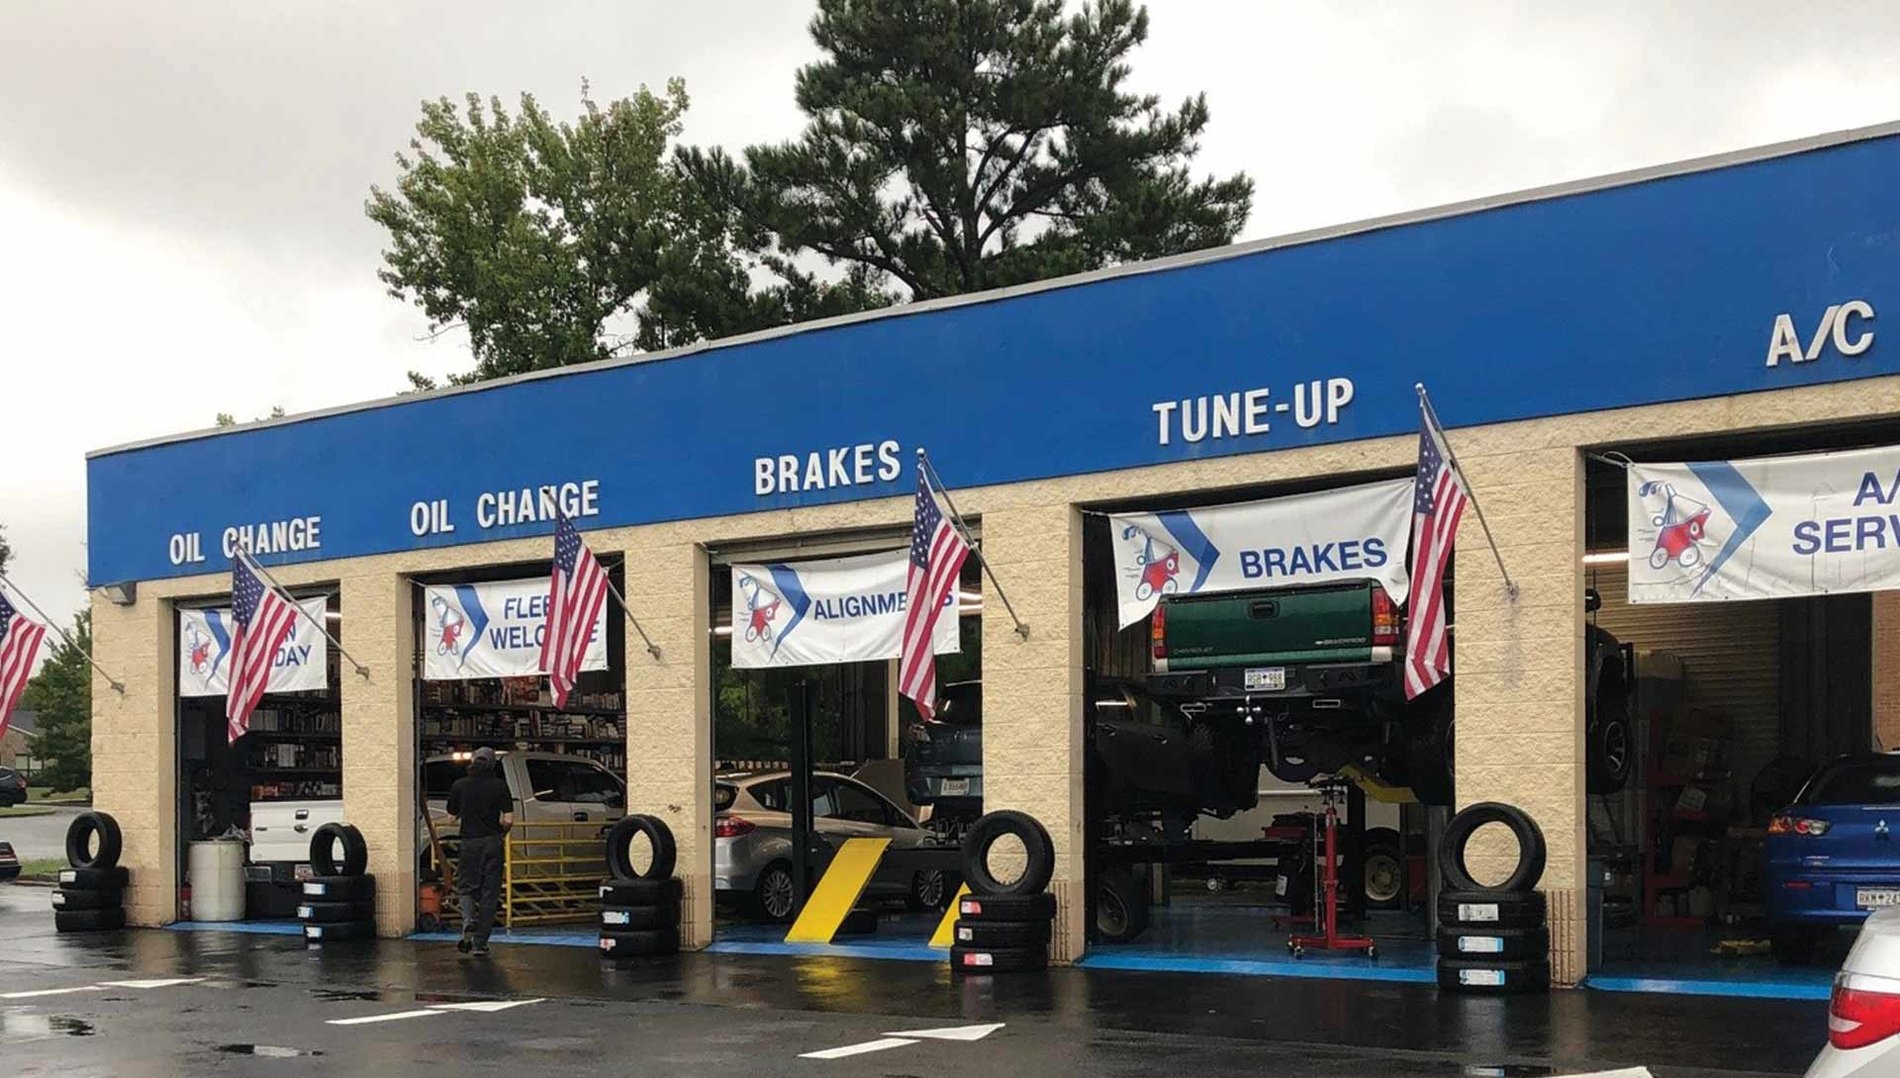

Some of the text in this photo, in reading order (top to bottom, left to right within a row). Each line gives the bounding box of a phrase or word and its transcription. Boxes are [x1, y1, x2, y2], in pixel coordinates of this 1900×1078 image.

[1766, 300, 1875, 367] A/C
[1152, 377, 1354, 445] TUNE-UP
[755, 440, 901, 495] BRAKES
[411, 480, 599, 536] OIL CHANGE
[169, 516, 321, 565] OIL CHANGE
[1240, 538, 1388, 579] BRAKES
[504, 594, 551, 619] FLE
[814, 588, 954, 620] ALIGNMES
[489, 620, 599, 650] WELCE
